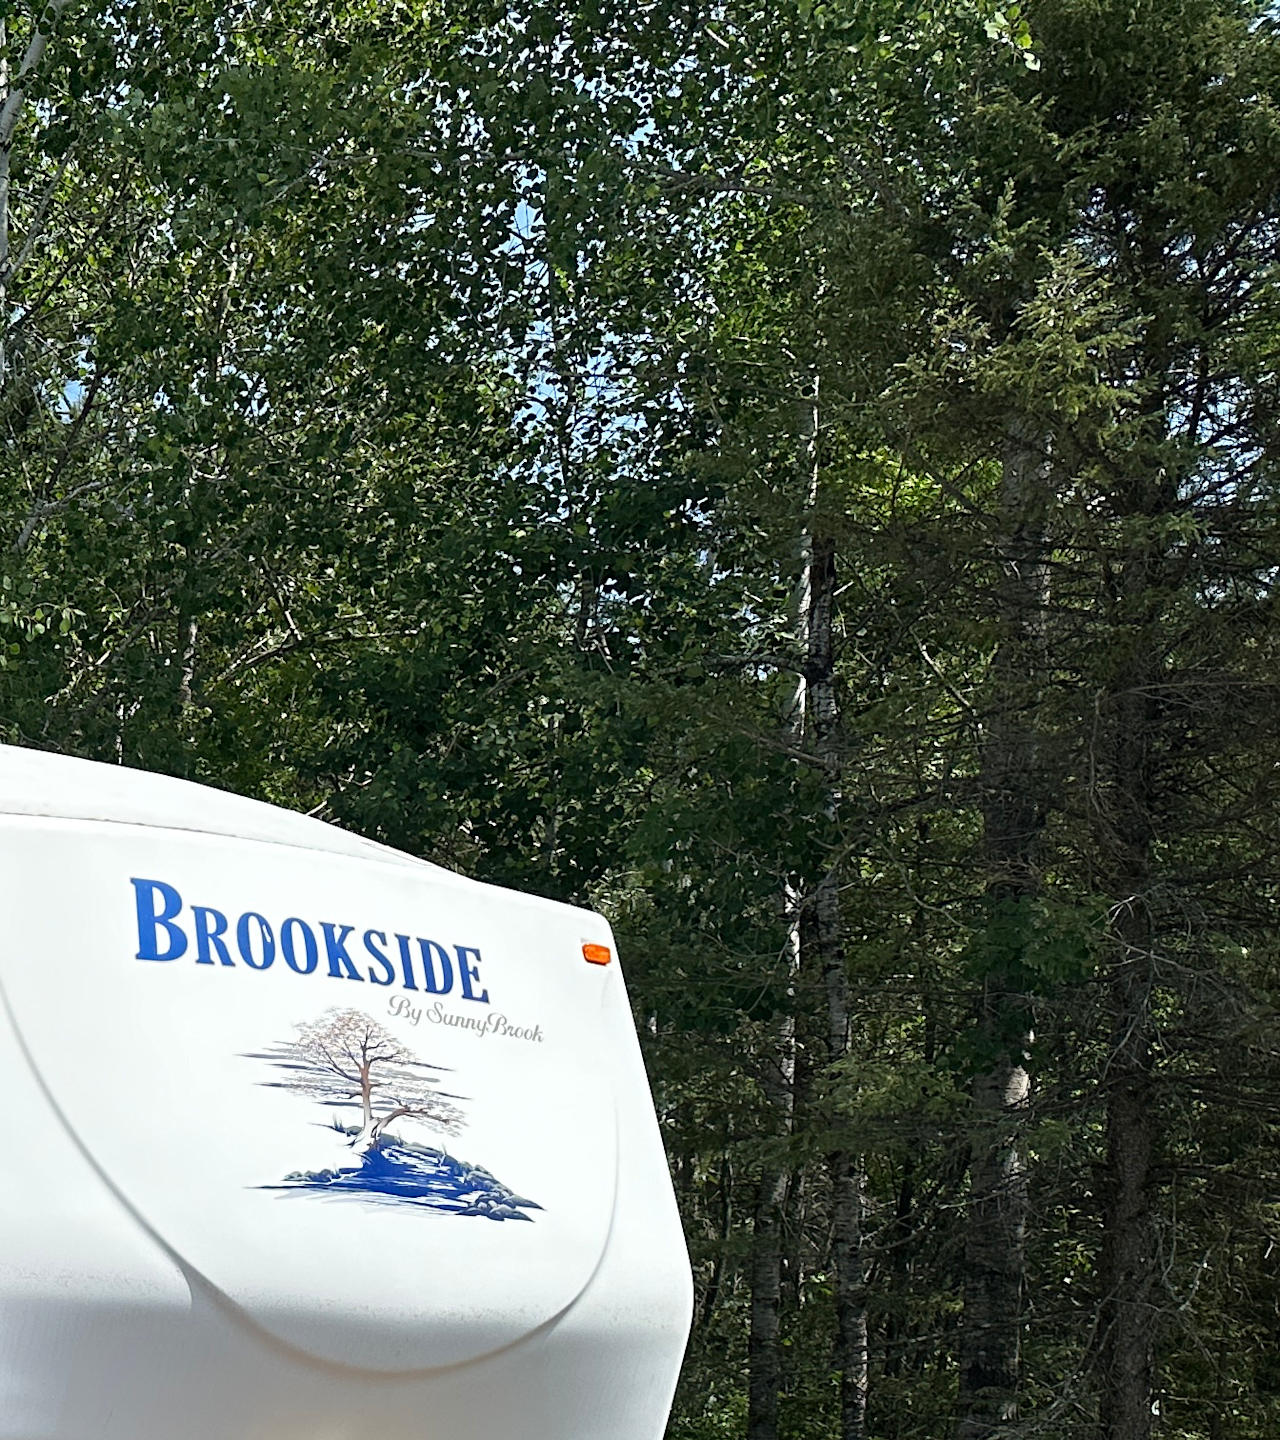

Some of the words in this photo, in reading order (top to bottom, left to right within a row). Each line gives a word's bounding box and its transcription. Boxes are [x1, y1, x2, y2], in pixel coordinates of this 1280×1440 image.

[130, 877, 490, 1004] BROOKSIDE
[387, 995, 422, 1026] By
[426, 1002, 544, 1043] SunnyBrook
